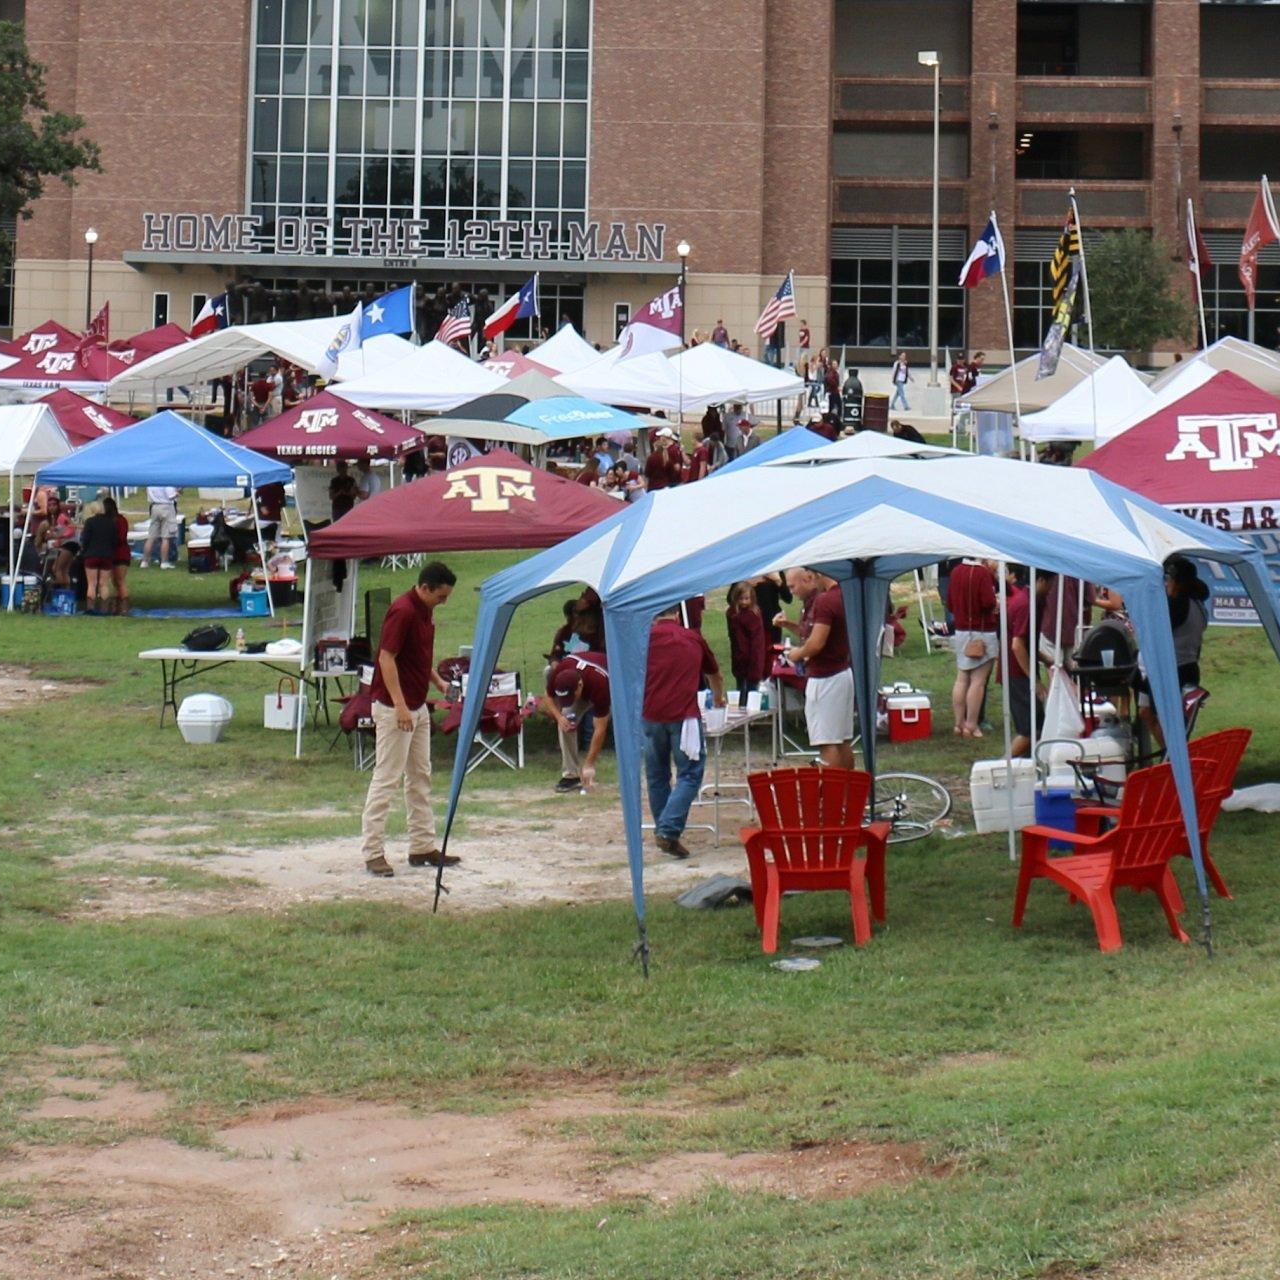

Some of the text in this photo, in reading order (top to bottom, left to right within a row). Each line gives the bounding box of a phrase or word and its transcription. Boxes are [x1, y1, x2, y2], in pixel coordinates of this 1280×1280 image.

[143, 213, 666, 261] HOME OF THE 12TH MAN
[276, 445, 337, 455] TEXAS AGGIES
